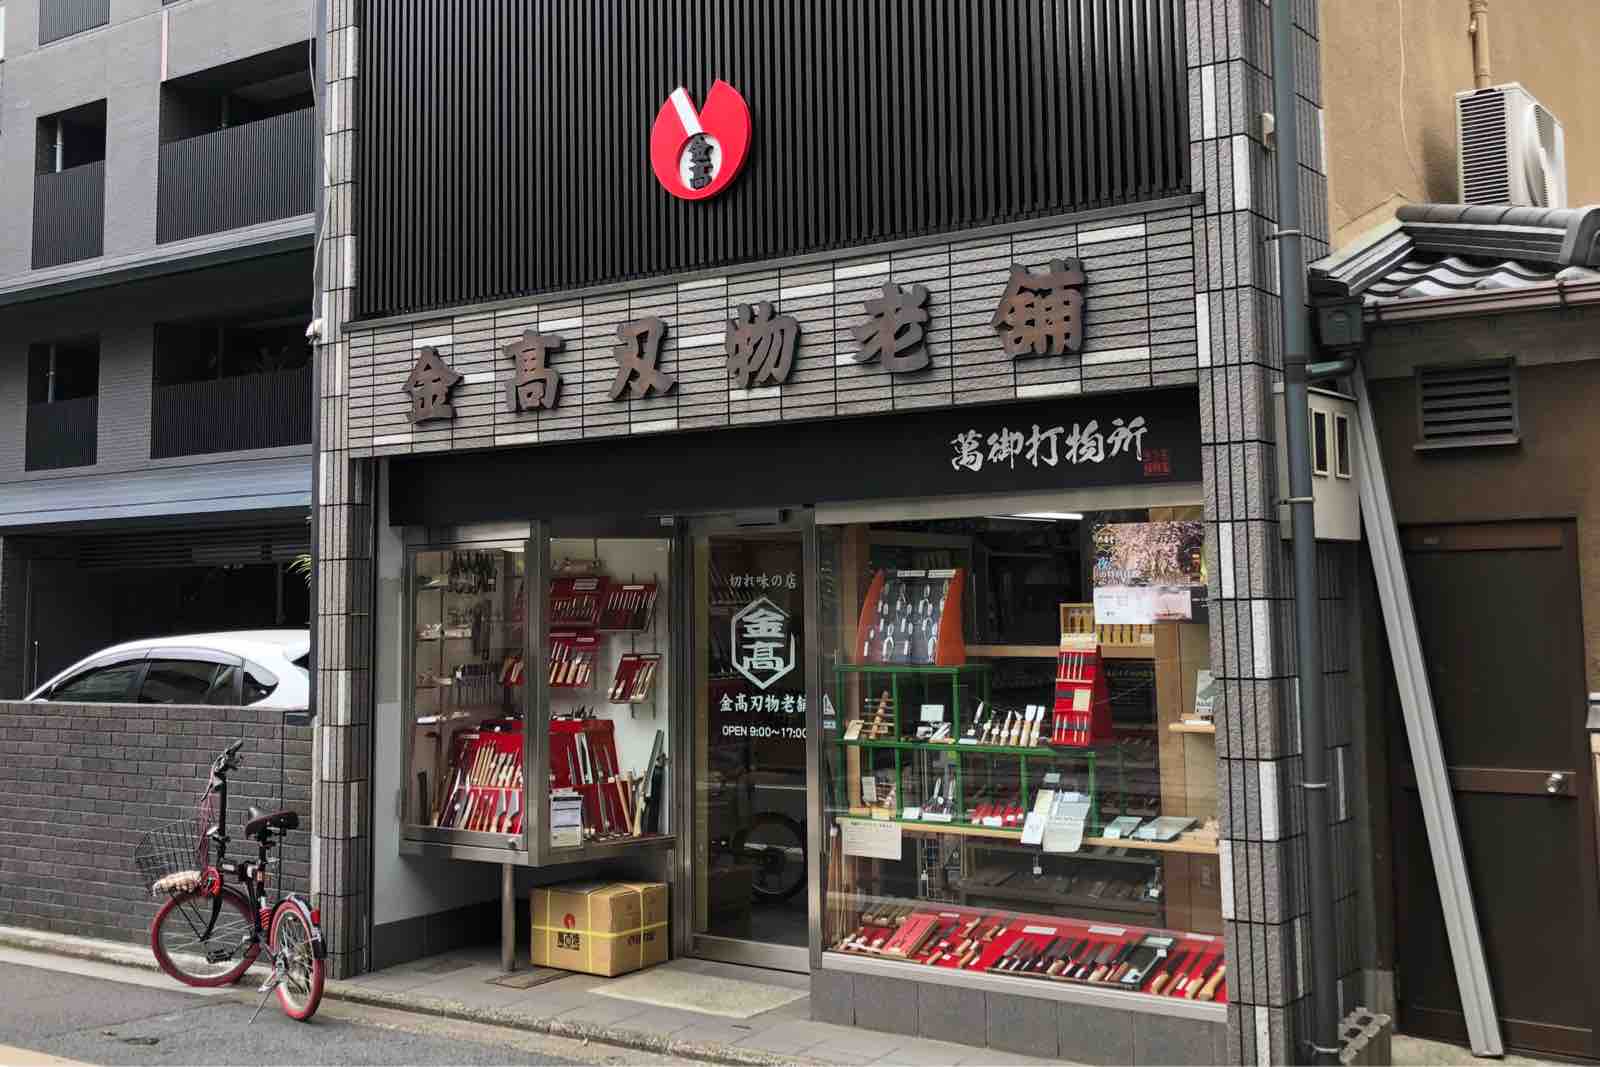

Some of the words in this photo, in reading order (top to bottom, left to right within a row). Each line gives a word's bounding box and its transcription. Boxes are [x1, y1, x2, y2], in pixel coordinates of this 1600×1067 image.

[728, 573, 797, 589] 切れ味の店
[722, 726, 747, 736] OPEN
